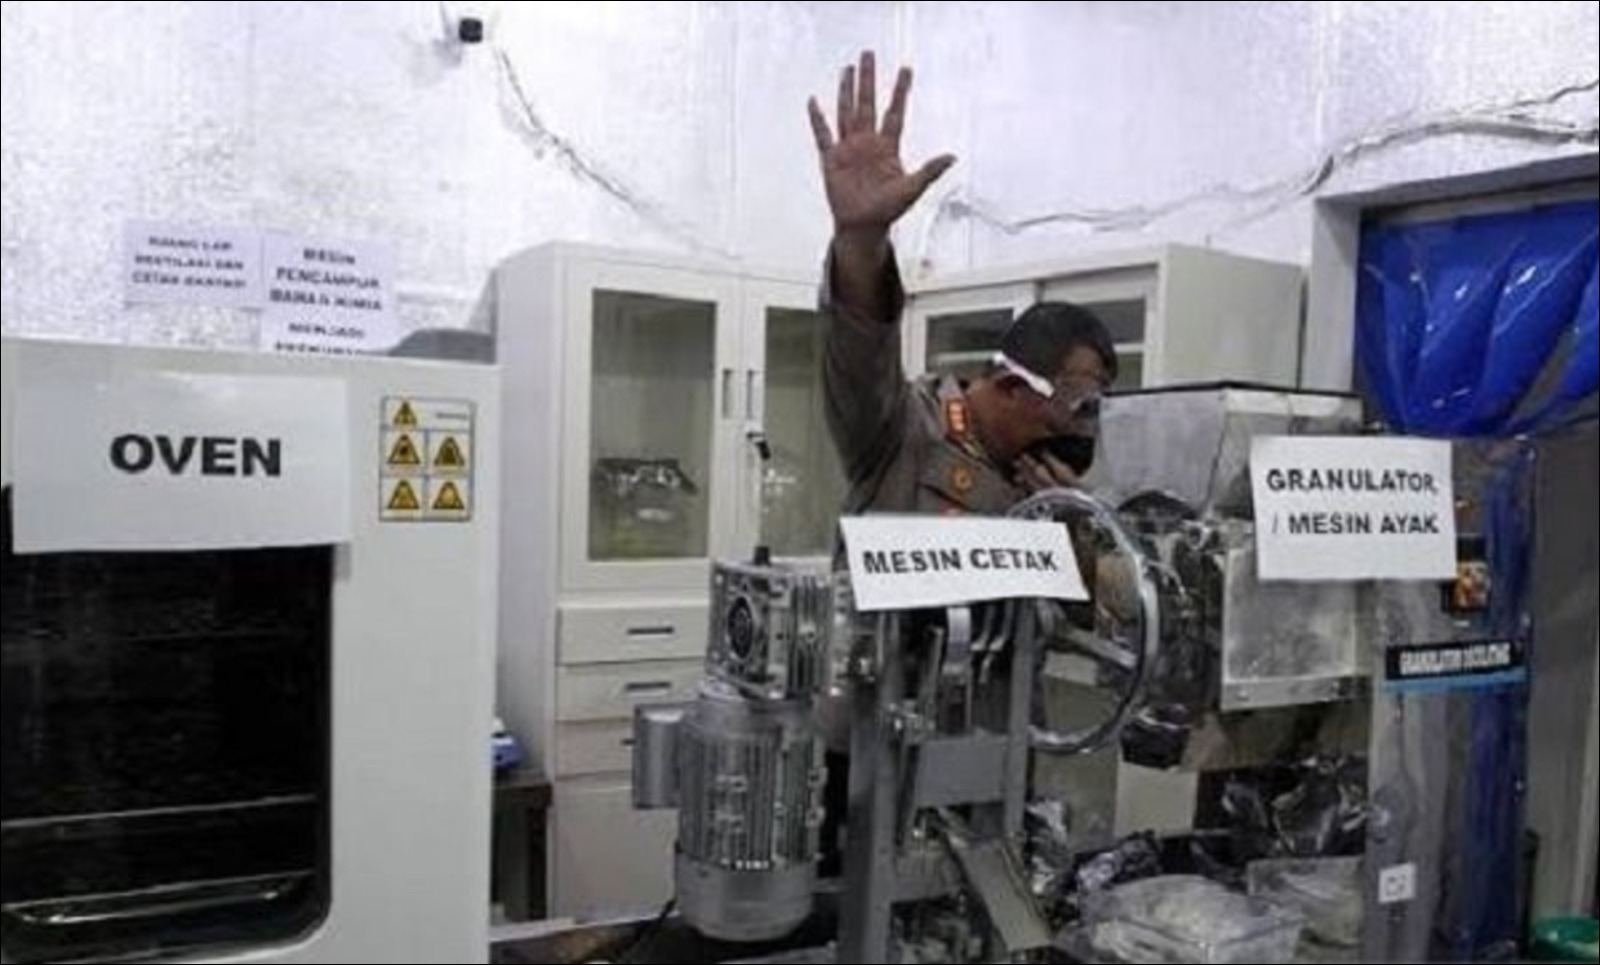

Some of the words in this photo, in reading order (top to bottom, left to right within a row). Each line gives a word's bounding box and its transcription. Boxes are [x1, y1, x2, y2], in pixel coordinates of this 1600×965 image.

[109, 434, 281, 477] OVEN
[1266, 468, 1438, 493] GRANULATOR
[1289, 512, 1370, 534] MESIN
[1380, 513, 1439, 534] AYAK
[863, 549, 962, 574] MESIN
[969, 548, 1058, 571] CETAK
